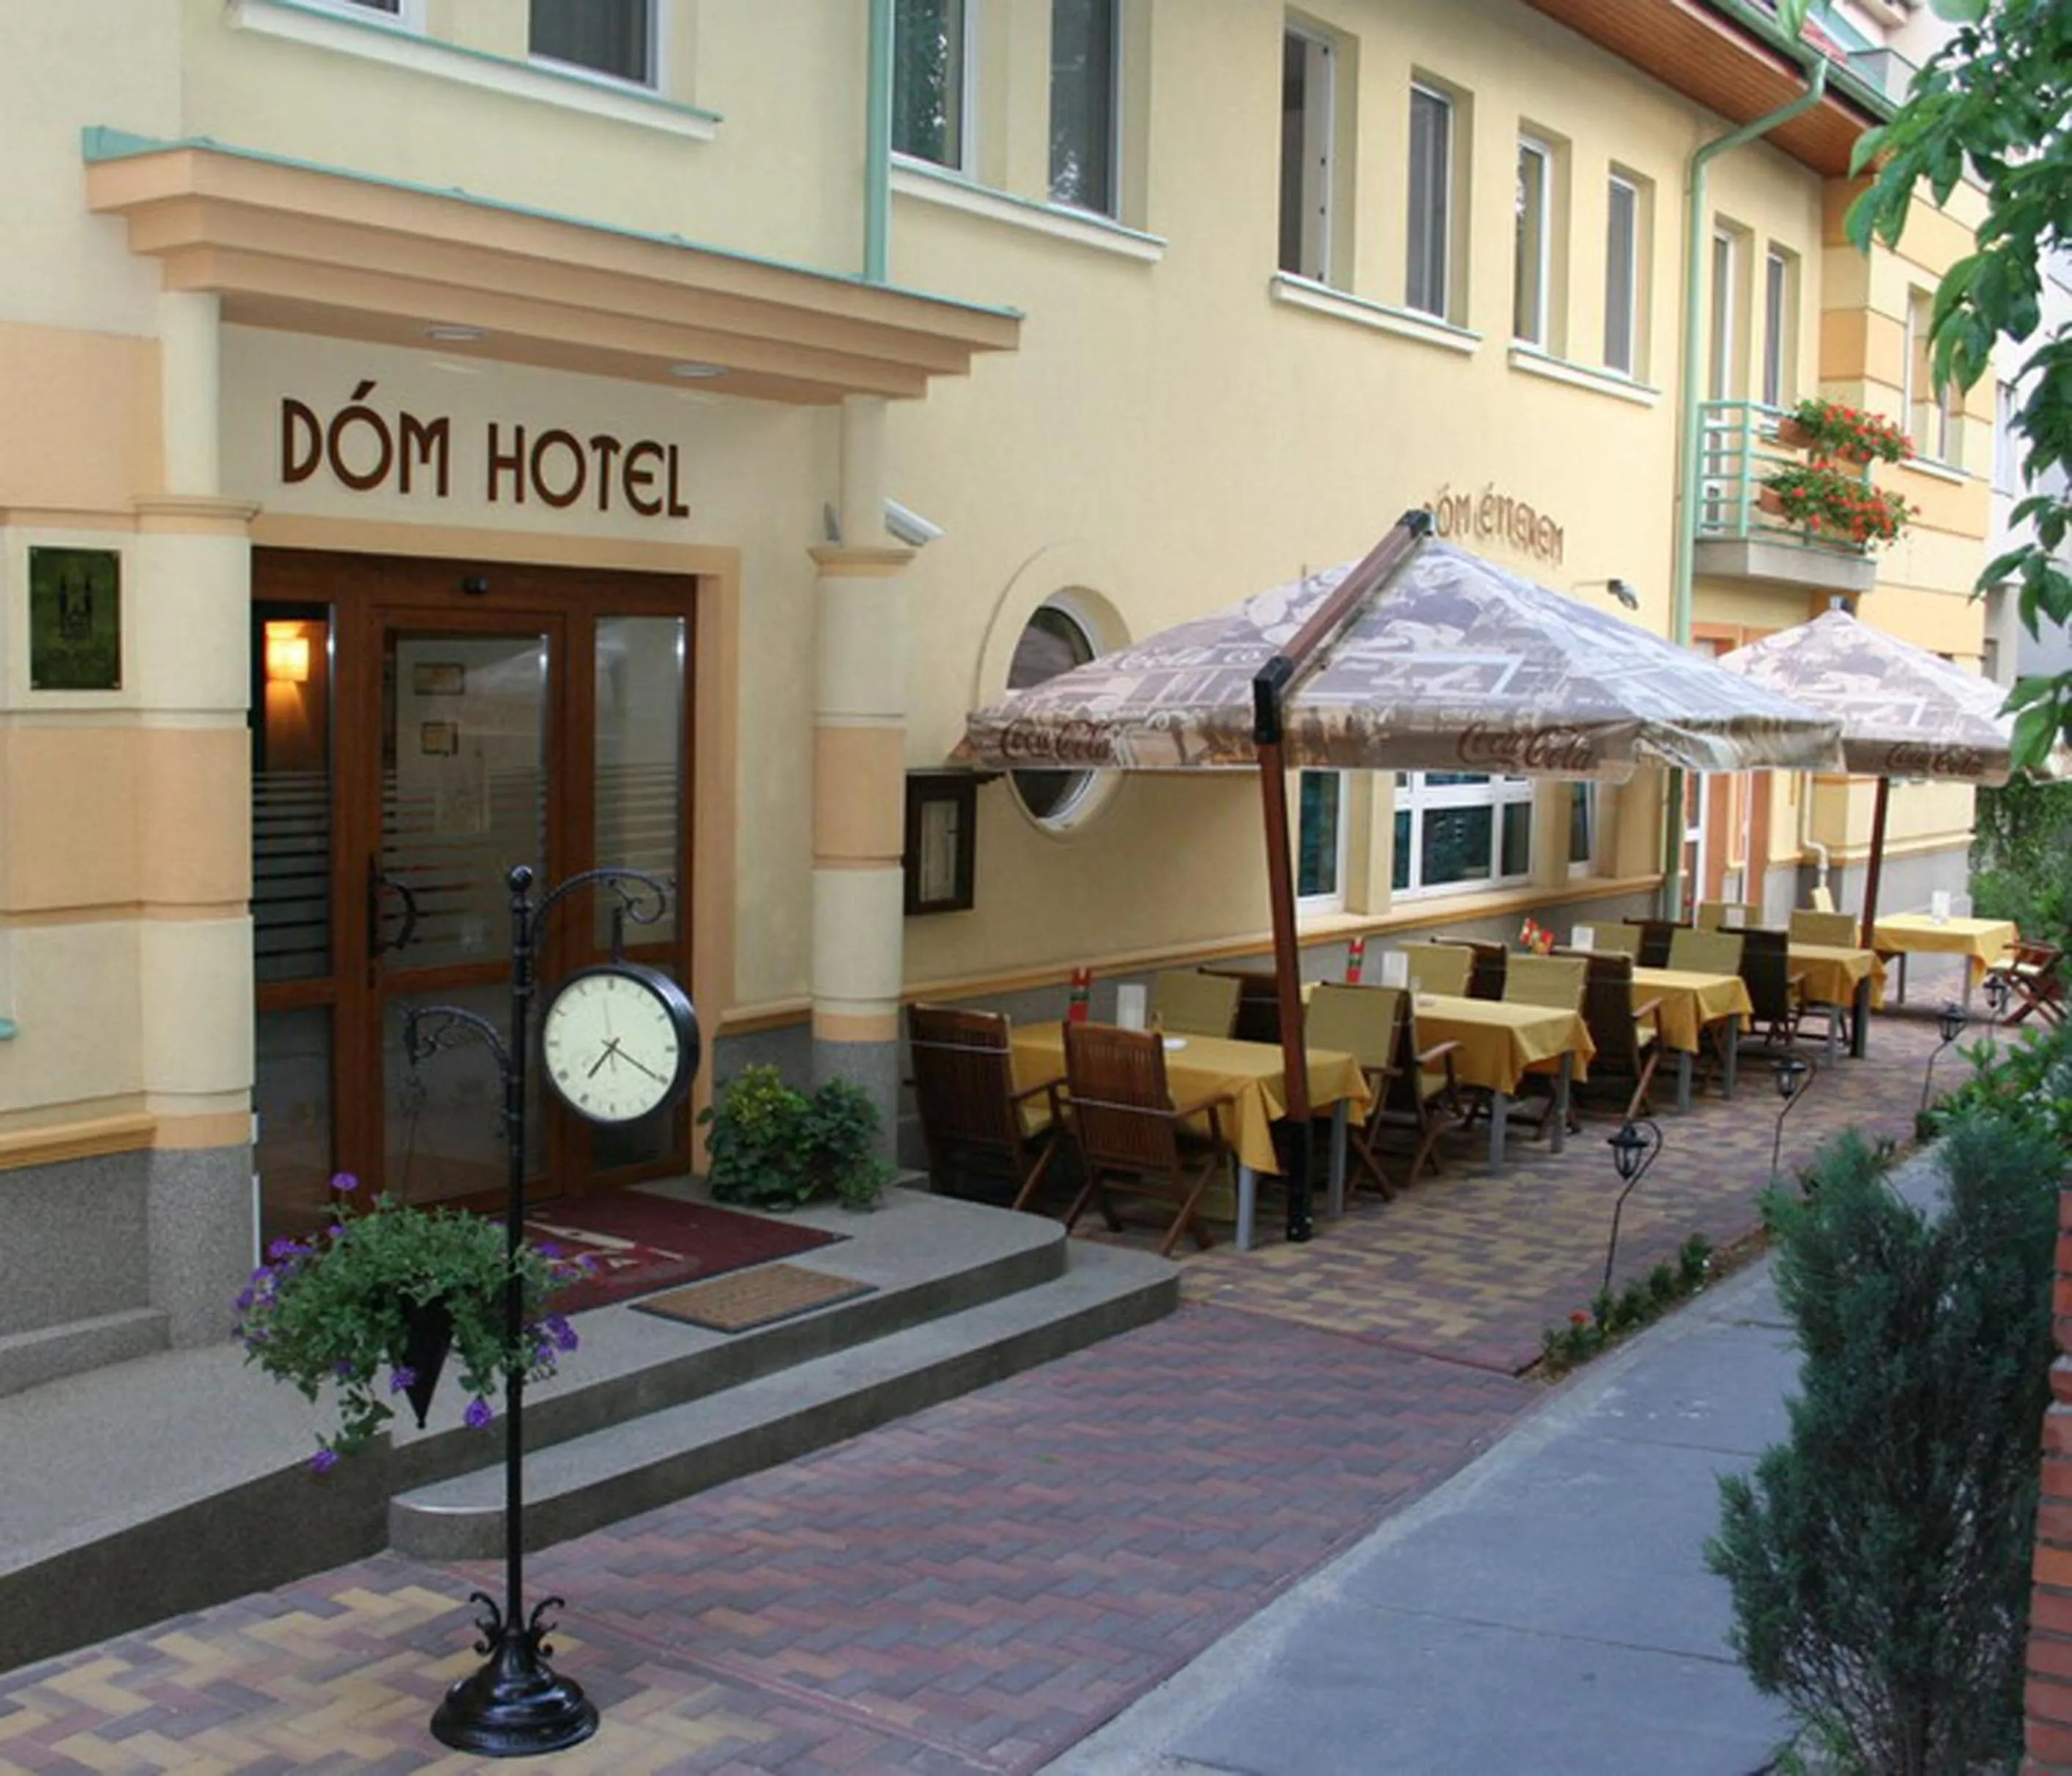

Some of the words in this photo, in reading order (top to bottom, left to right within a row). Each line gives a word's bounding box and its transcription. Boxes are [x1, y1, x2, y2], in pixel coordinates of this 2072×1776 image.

[282, 380, 450, 497] DÓM
[487, 423, 690, 518] HOTEL
[1423, 482, 1471, 538] ÓM
